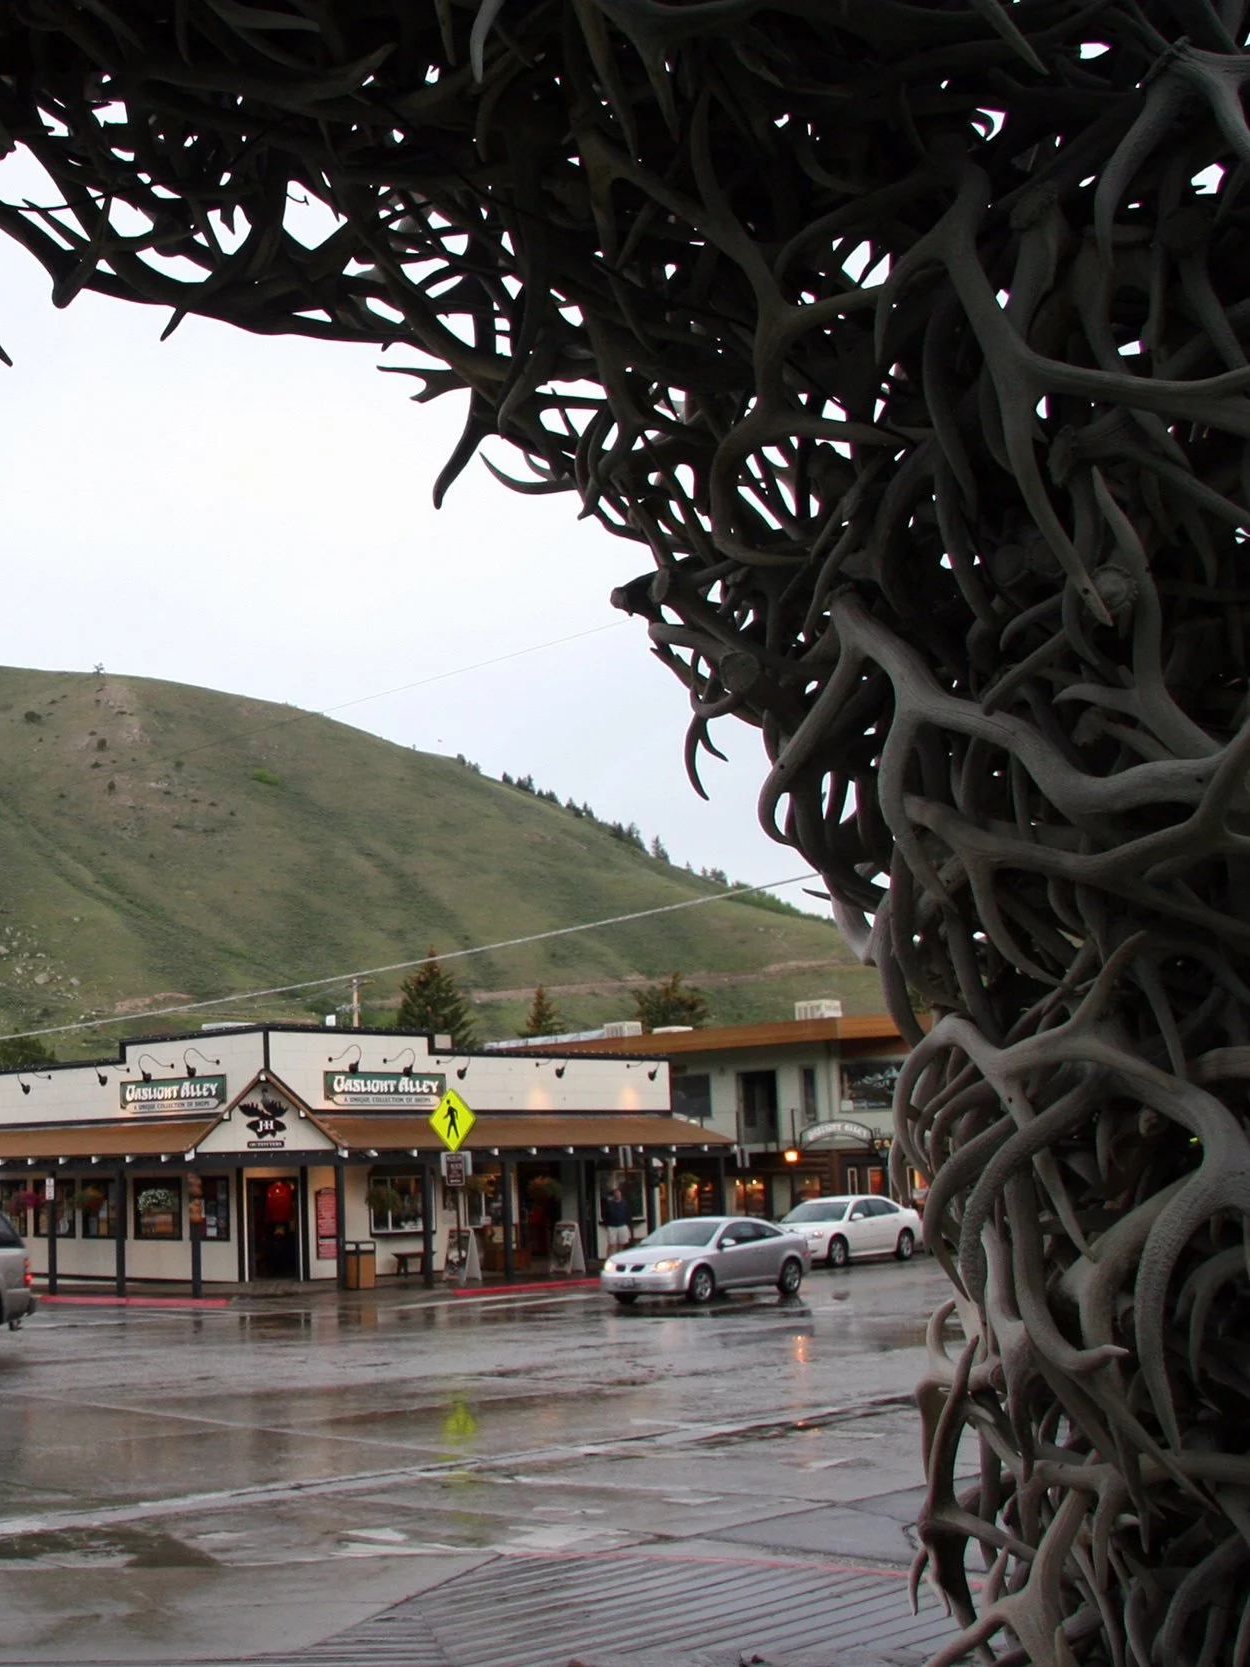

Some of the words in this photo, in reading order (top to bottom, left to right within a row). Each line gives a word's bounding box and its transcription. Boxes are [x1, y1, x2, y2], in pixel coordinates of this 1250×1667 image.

[125, 1084, 180, 1102] GASLIGHT
[180, 1081, 219, 1099] ALLEY
[333, 1075, 397, 1093] GASLIGHT
[397, 1076, 440, 1094] ALLEY
